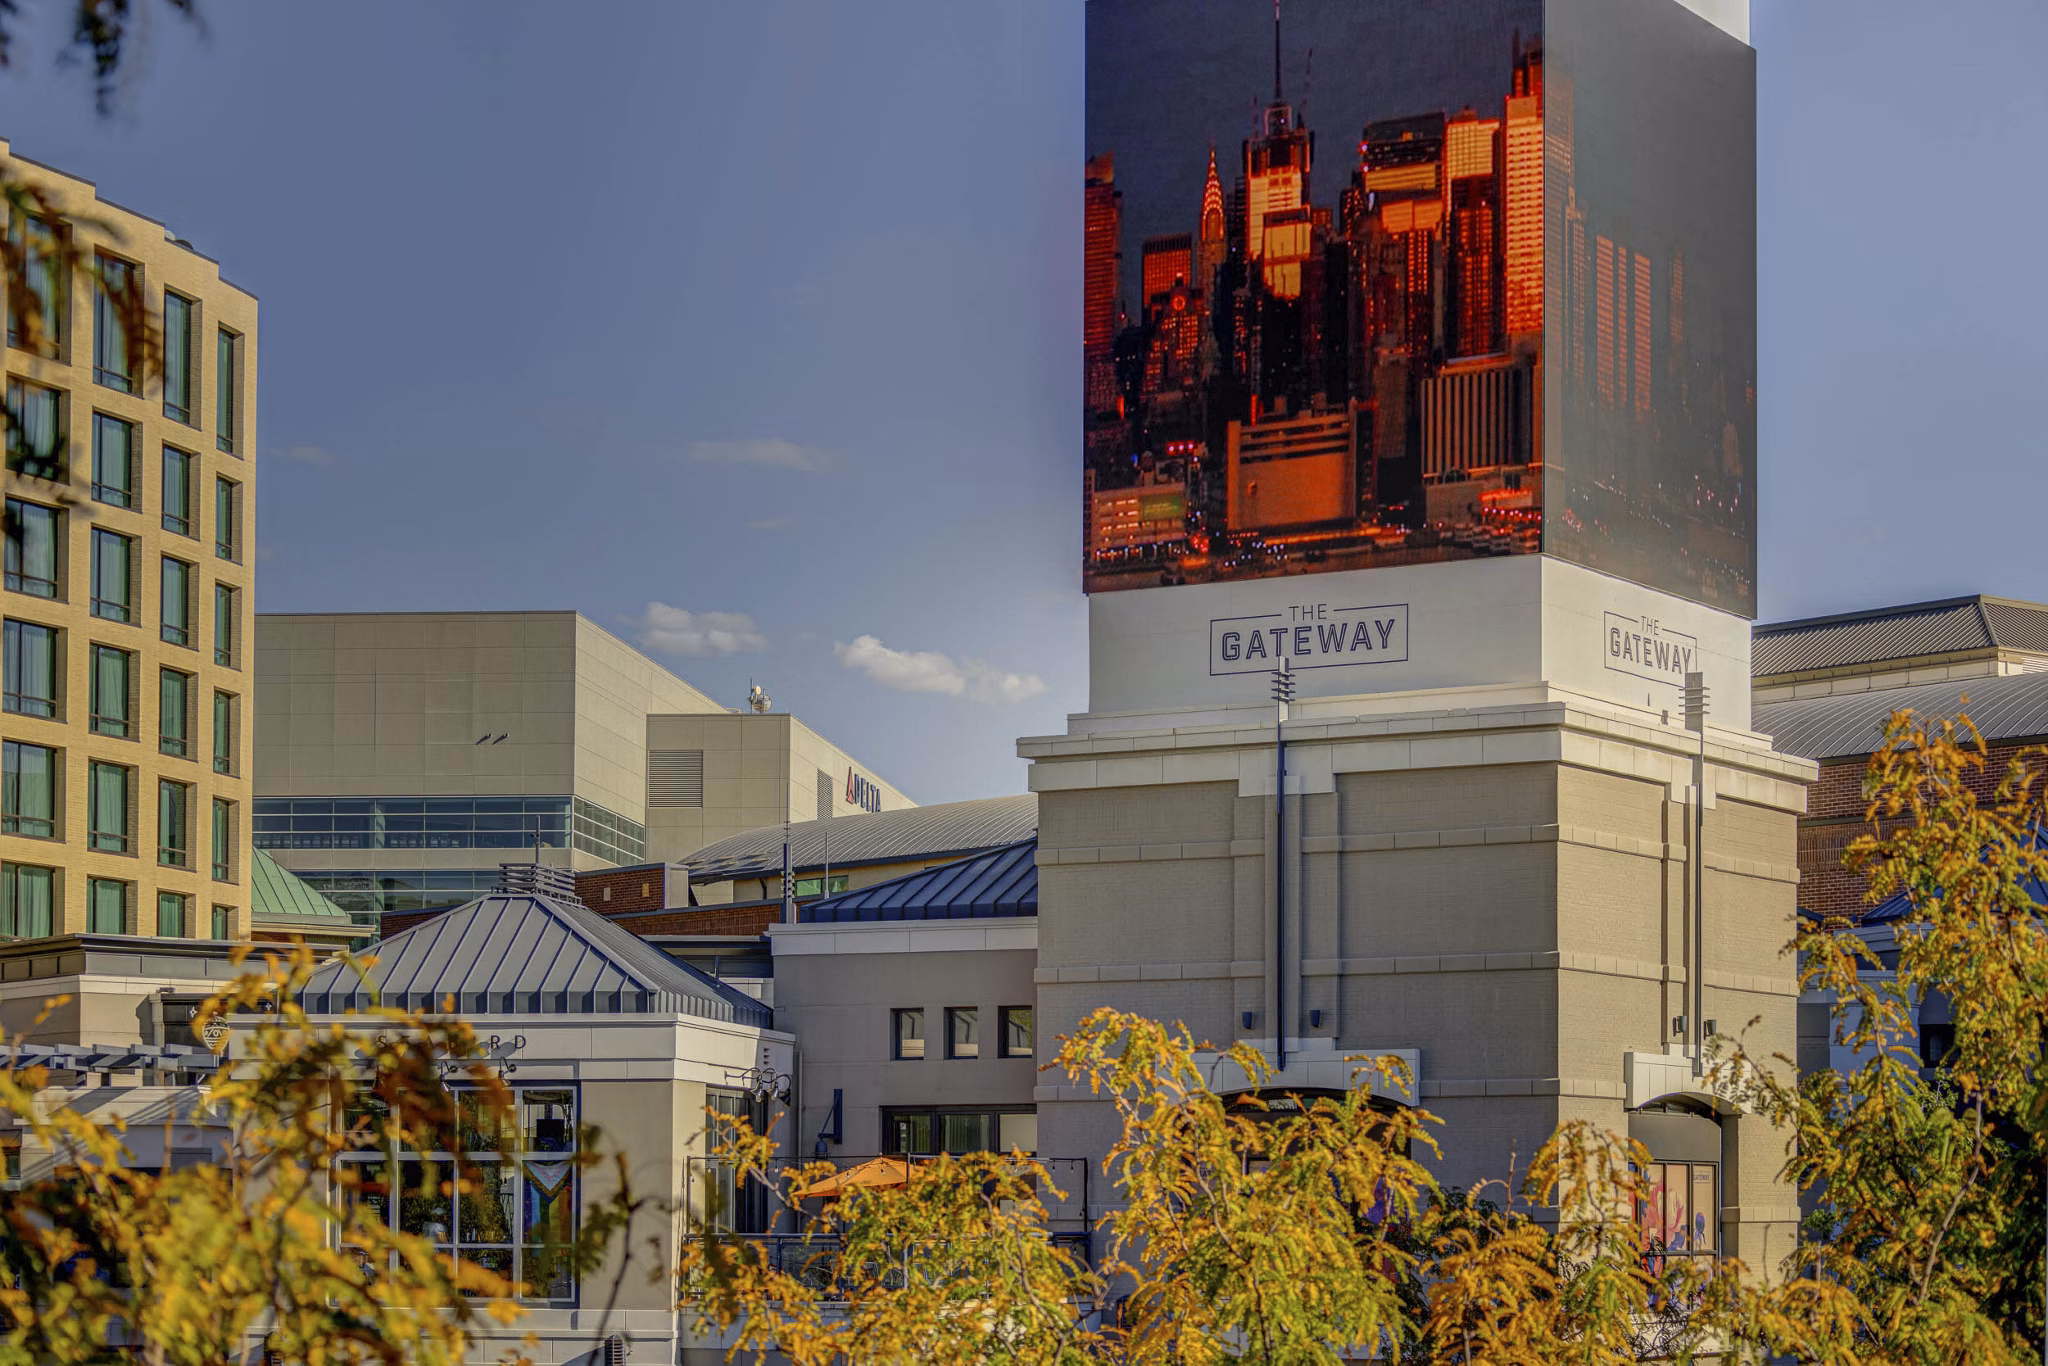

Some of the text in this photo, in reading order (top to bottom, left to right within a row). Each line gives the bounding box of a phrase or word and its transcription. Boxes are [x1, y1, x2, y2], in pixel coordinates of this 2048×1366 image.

[1288, 604, 1328, 622] THE
[1641, 615, 1660, 636] THE
[1222, 619, 1395, 661] GATEWAY
[1610, 627, 1691, 674] GATEWAY
[854, 773, 881, 814] DELTA
